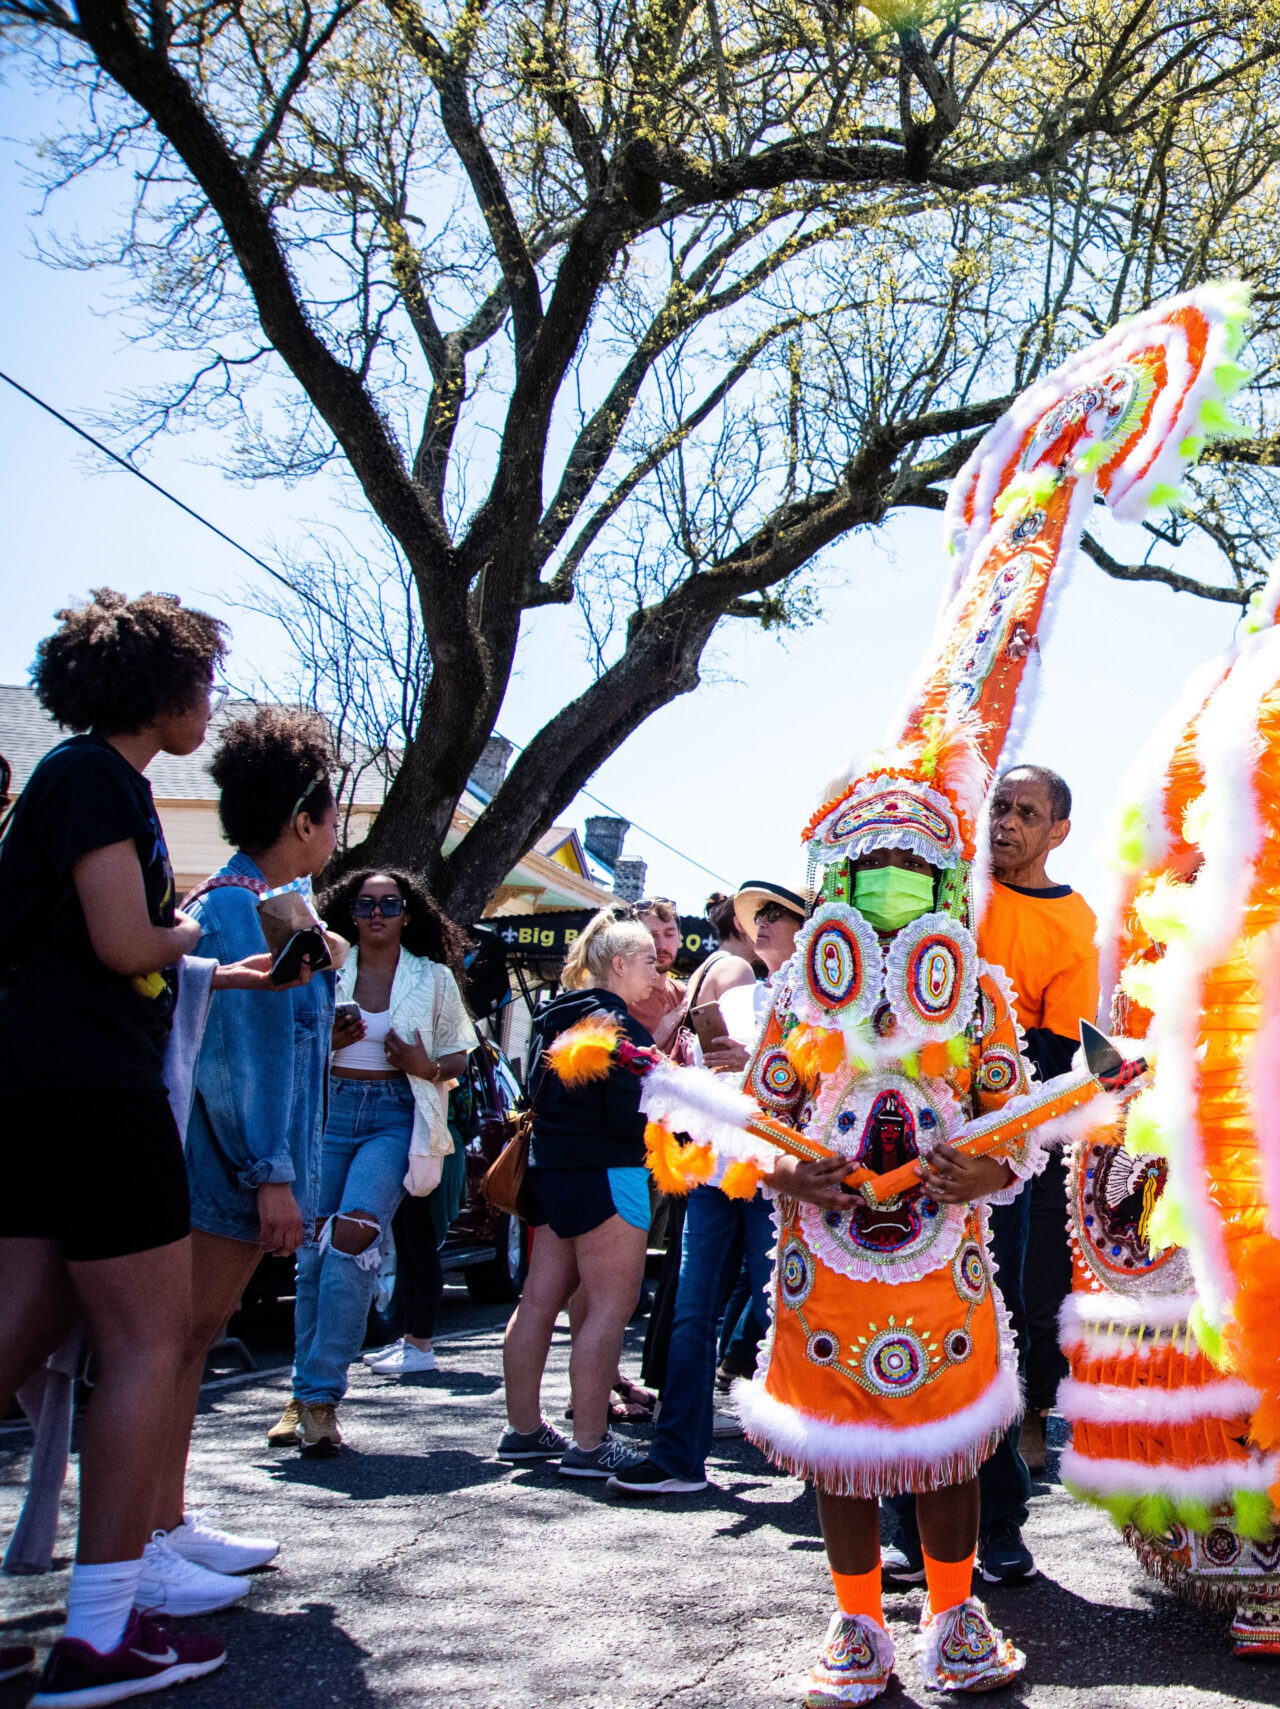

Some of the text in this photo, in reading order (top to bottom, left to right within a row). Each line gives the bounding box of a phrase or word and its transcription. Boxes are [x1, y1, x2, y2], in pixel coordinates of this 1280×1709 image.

[518, 927, 555, 947] Big
[564, 929, 579, 944] B
[539, 1429, 559, 1447] N
[598, 1449, 625, 1469] N
